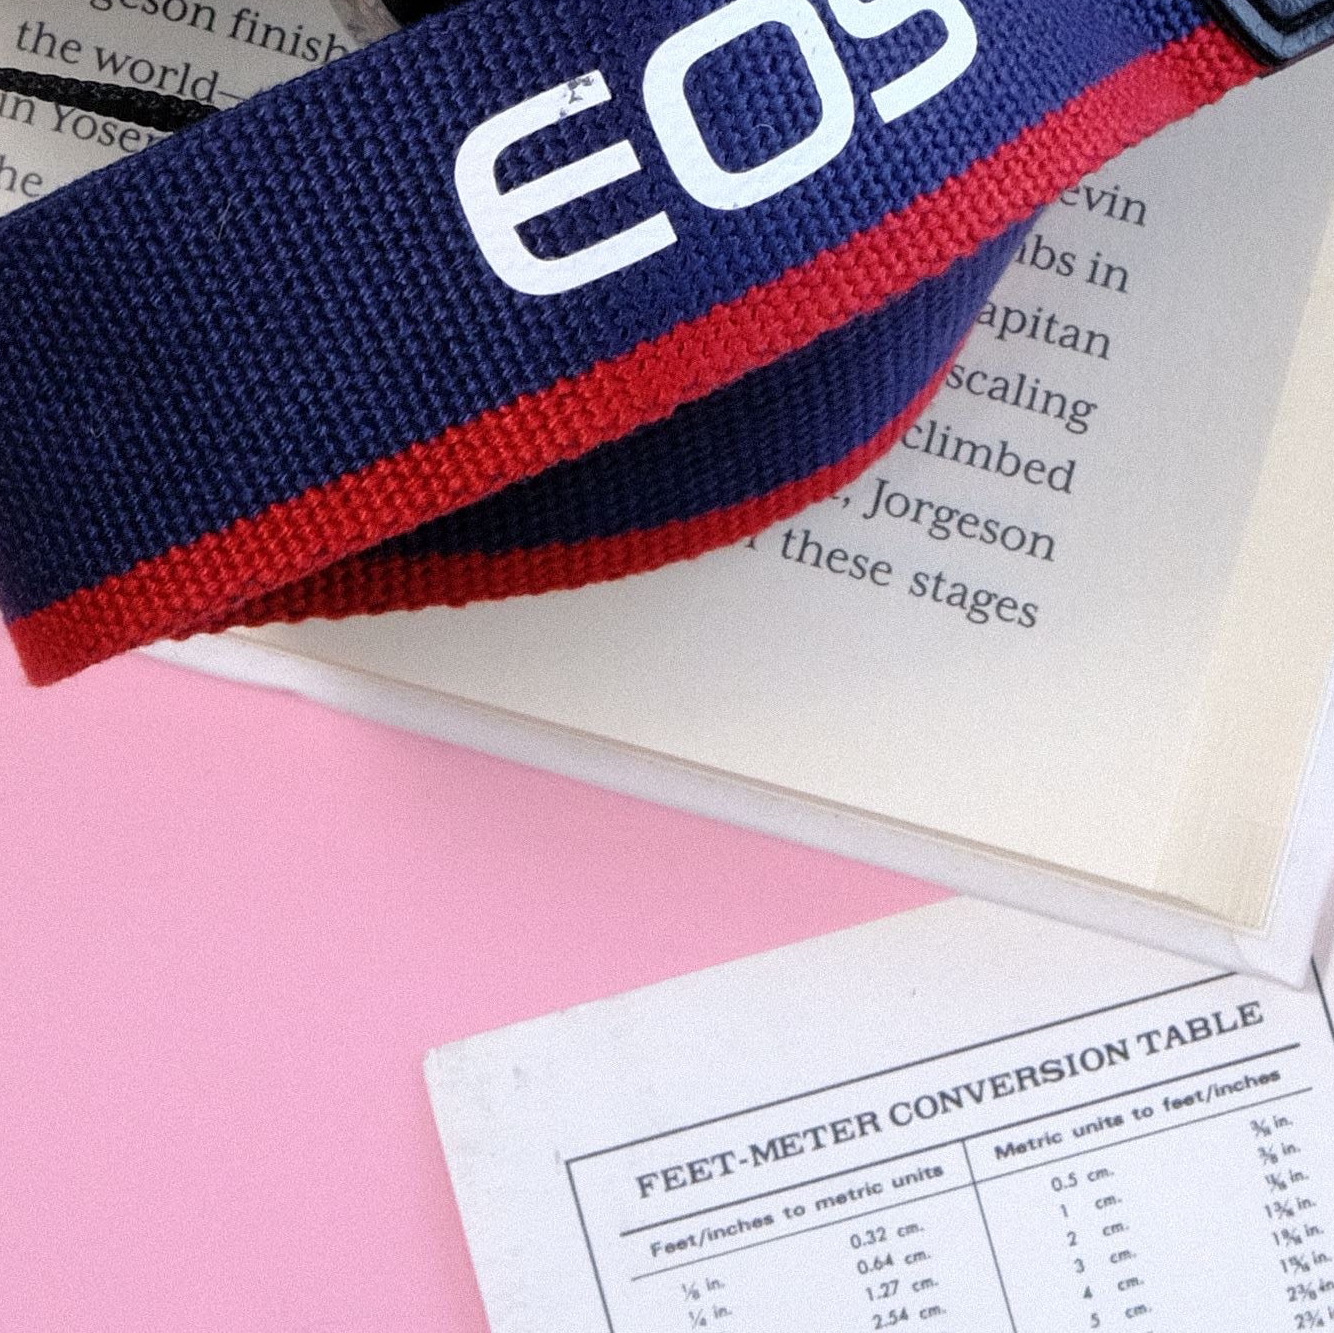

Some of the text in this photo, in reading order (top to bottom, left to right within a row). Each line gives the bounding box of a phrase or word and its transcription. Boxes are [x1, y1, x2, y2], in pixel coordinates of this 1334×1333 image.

[16, 20, 83, 63] the
[945, 363, 1098, 435] scaling
[901, 421, 1076, 495] climbed
[861, 478, 1056, 563] Jorgeson
[781, 529, 1040, 630] these stages
[635, 1000, 1265, 1199] FEET-METER CONVERSION TABLE
[994, 1070, 1281, 1160] Metric units to feet/inches
[1051, 1168, 1114, 1192] 0.5 cm.
[650, 1166, 944, 1257] Feet/inches to metric units
[1095, 1195, 1122, 1210] cm.
[850, 1223, 924, 1249] 0.32 cm.
[1067, 1222, 1129, 1247] 2 cm.
[856, 1250, 931, 1275] 0.64 cm.
[1074, 1249, 1136, 1274] 3 cm.
[866, 1278, 938, 1301] 1.27 cm.
[872, 1305, 946, 1330] 2.54 cm.
[1090, 1304, 1152, 1329] 5 cm.
